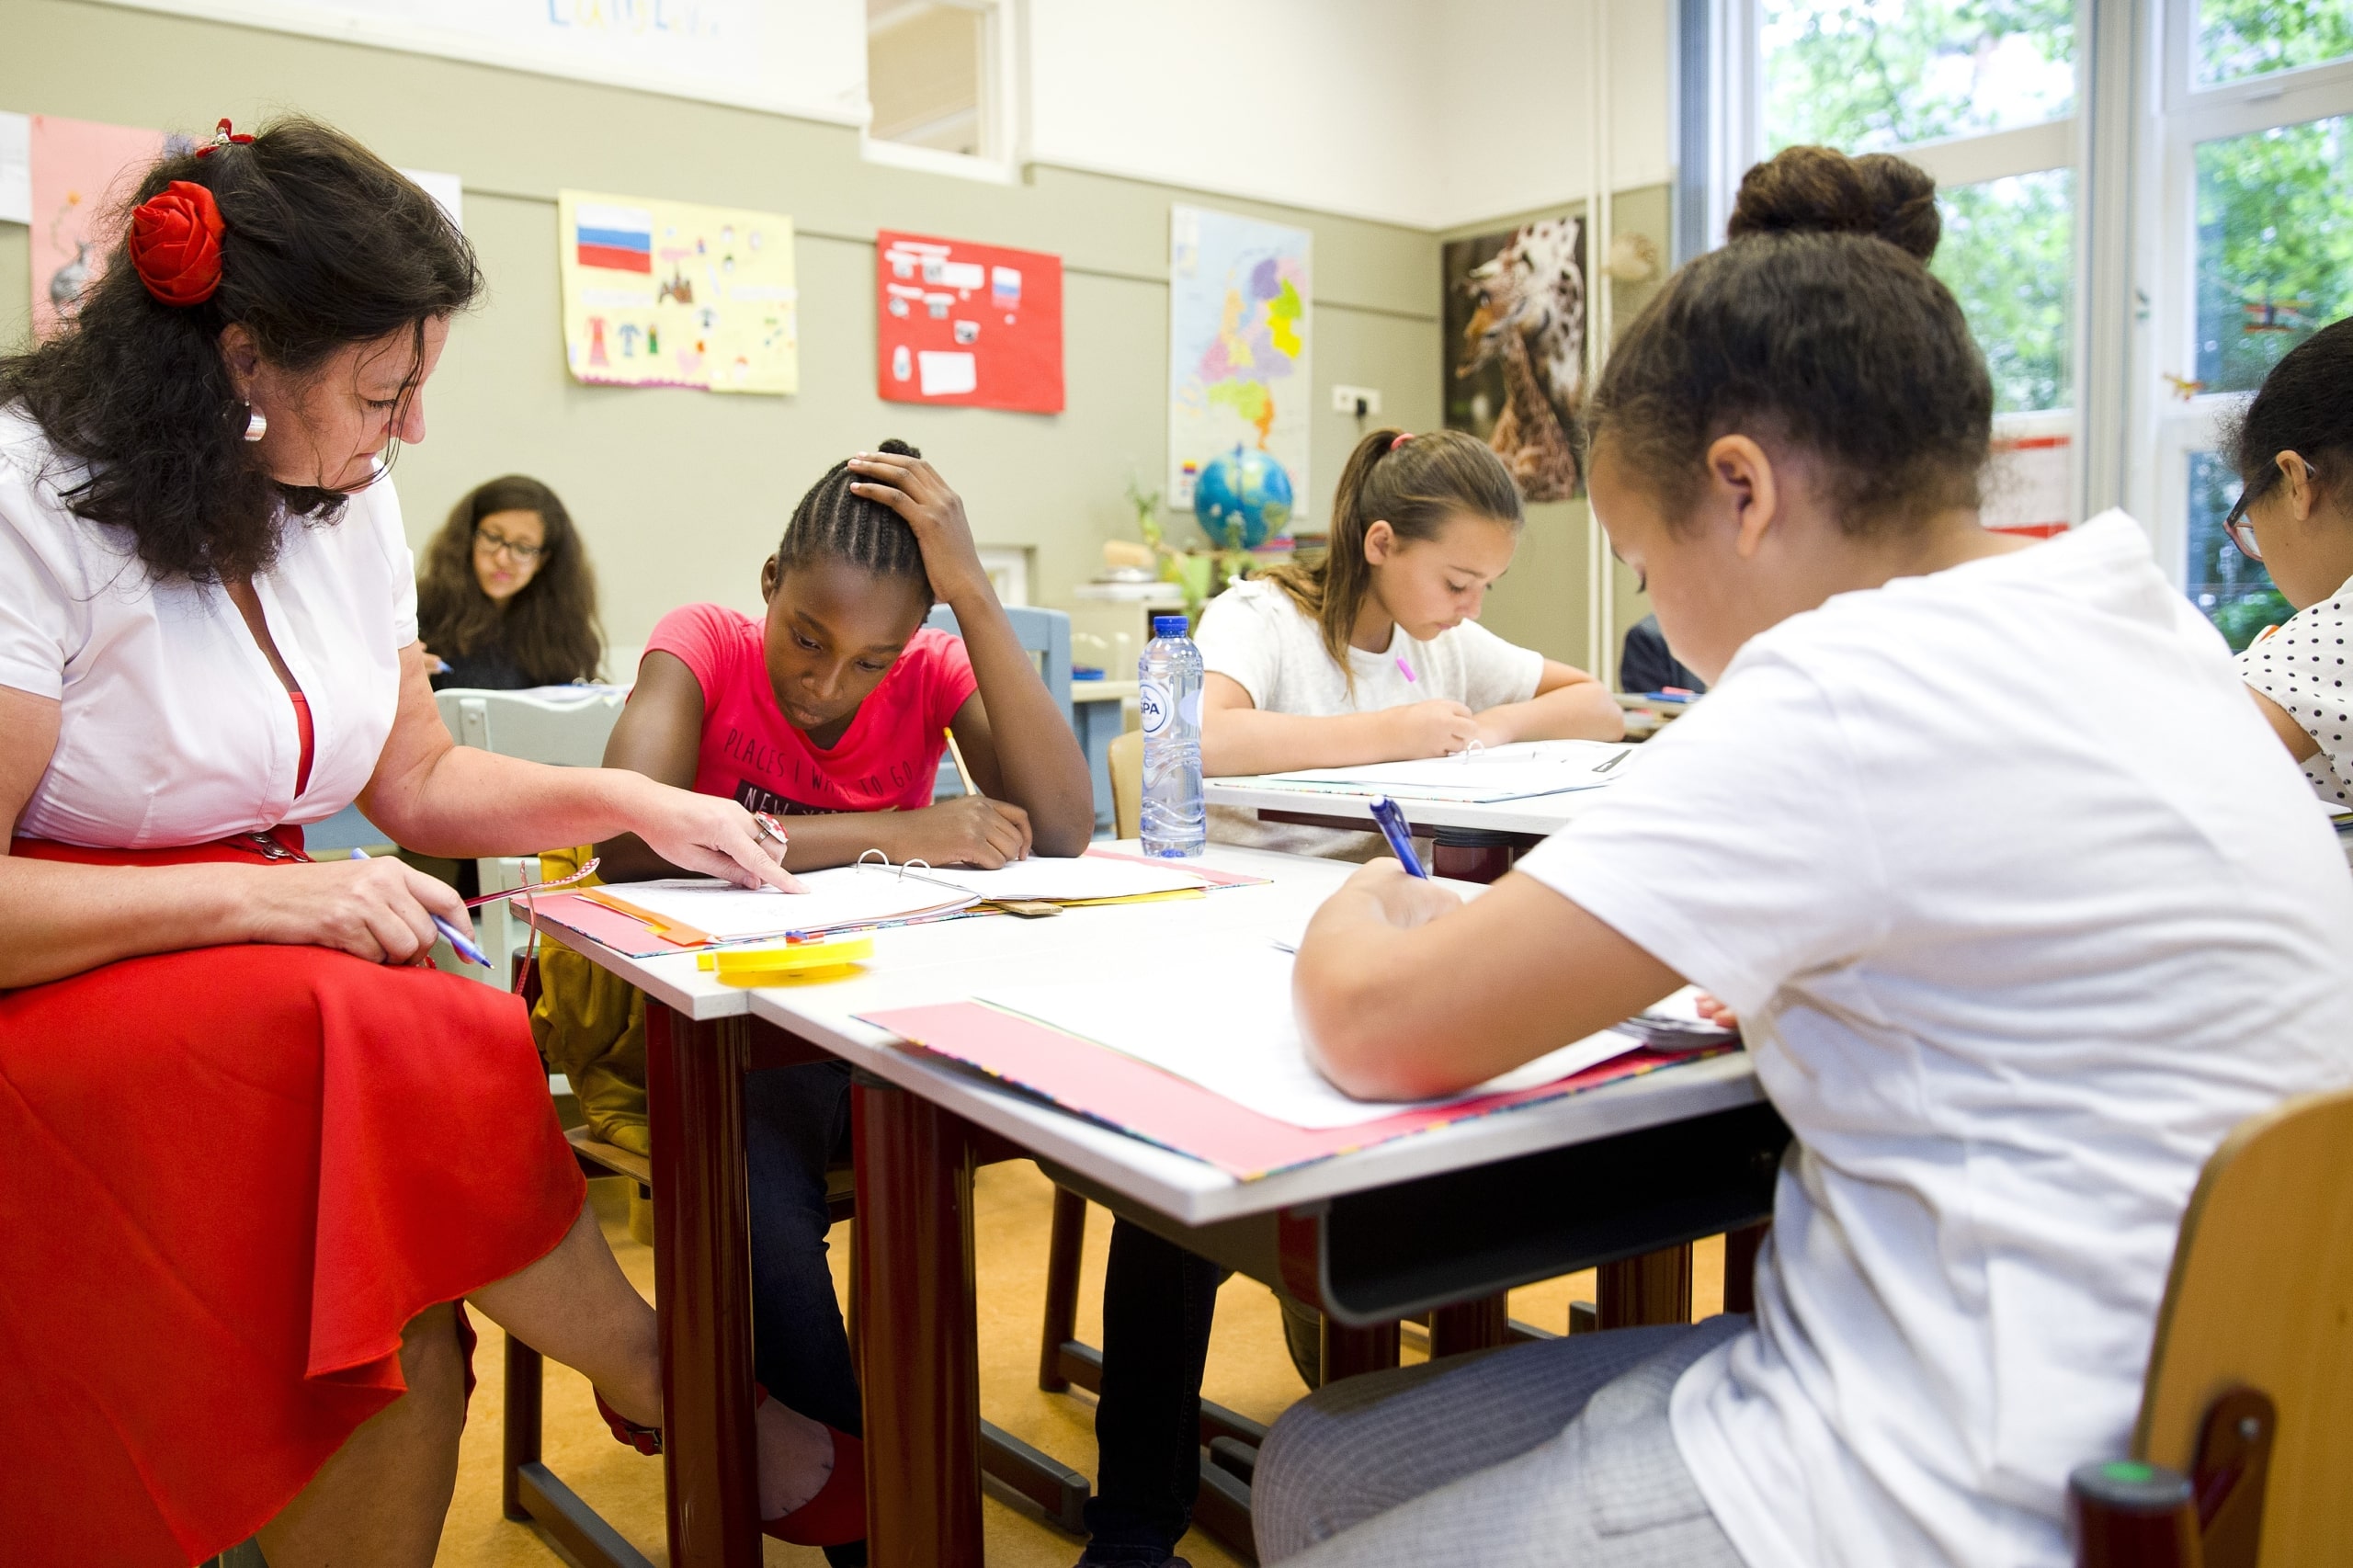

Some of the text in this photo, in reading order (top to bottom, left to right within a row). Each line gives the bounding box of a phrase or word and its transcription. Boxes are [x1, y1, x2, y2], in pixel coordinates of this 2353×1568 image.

[724, 728, 787, 778] PLACES
[794, 759, 801, 783] I
[859, 776, 884, 797] TO
[891, 760, 914, 789] GO
[744, 787, 790, 815] NEW
